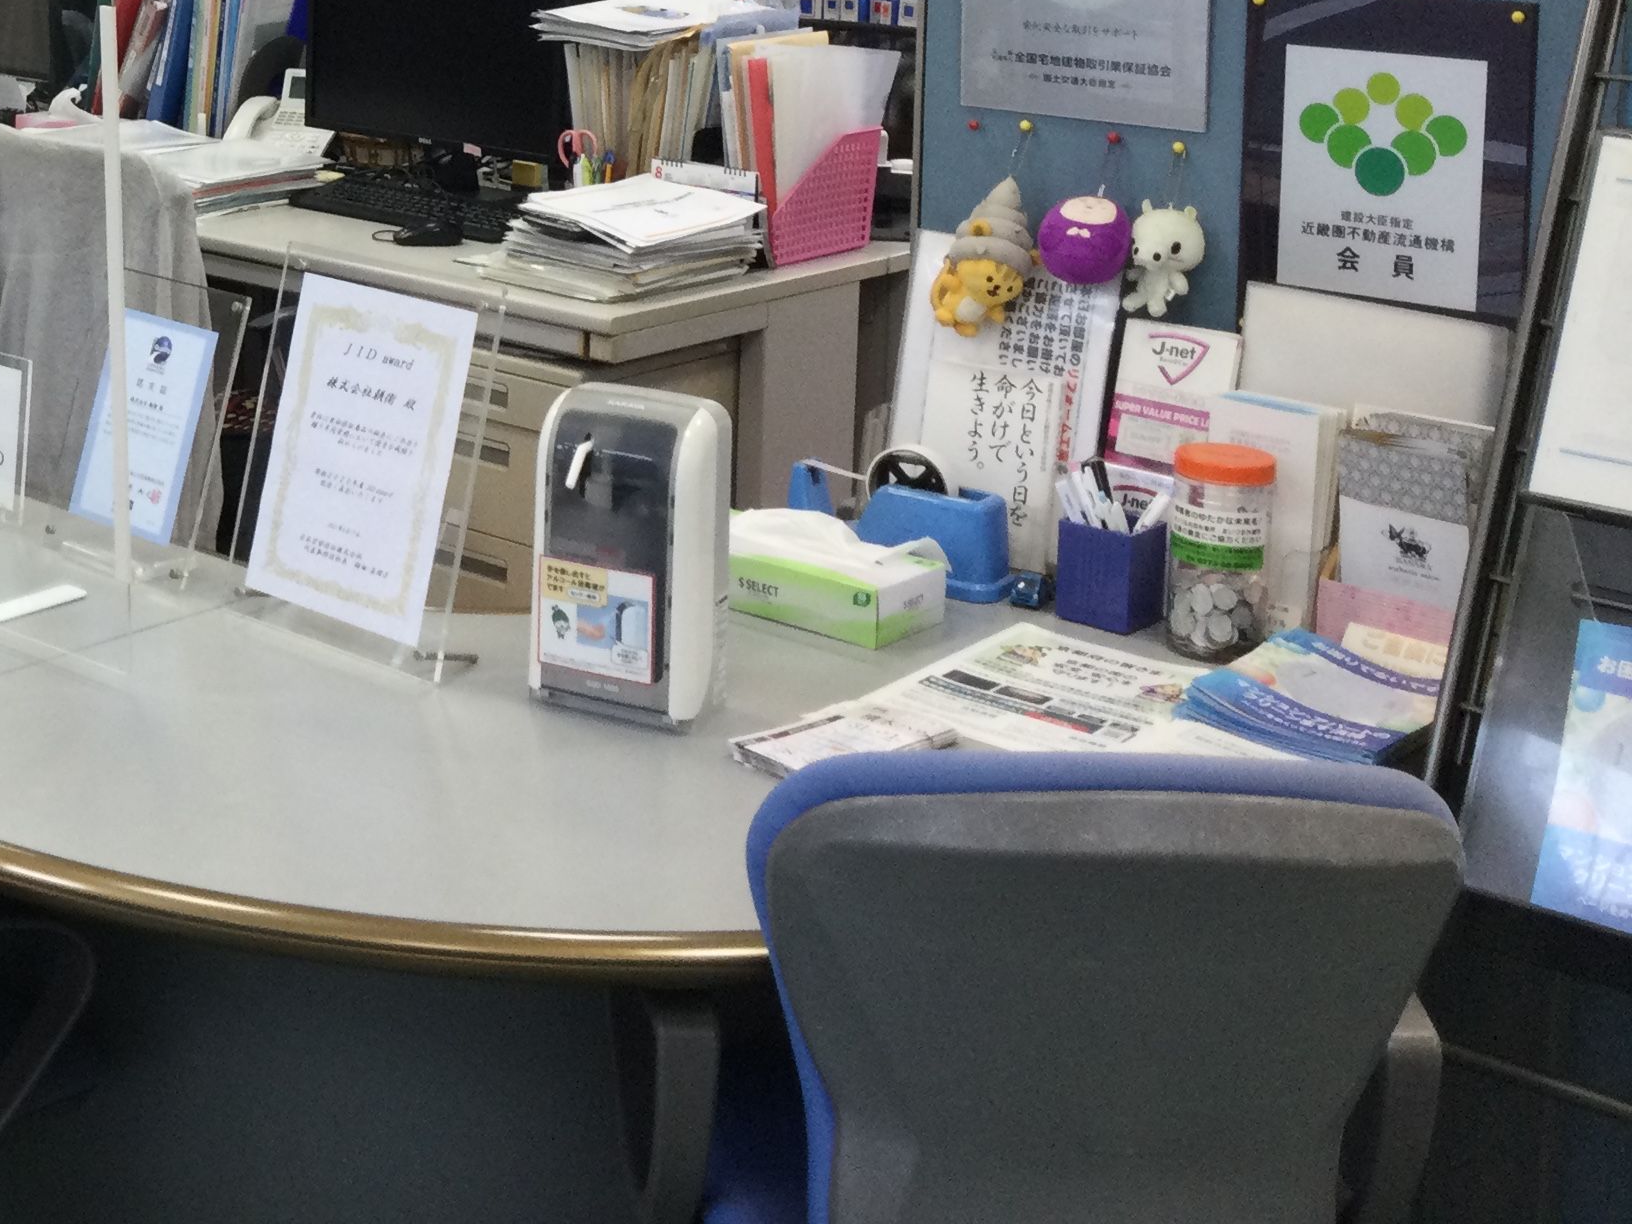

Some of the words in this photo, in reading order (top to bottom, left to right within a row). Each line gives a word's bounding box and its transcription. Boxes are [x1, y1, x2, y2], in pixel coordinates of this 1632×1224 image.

[1340, 210, 1414, 230] 建設大臣指定
[382, 355, 414, 370] award
[967, 370, 991, 470] 生きよう。
[988, 374, 1017, 463] 命がけで
[1114, 399, 1141, 413] SUPER
[1142, 406, 1172, 420] VALUE
[1173, 412, 1200, 425] PRICE
[1009, 377, 1043, 527] 今日という日を
[746, 579, 779, 598] SELECT
